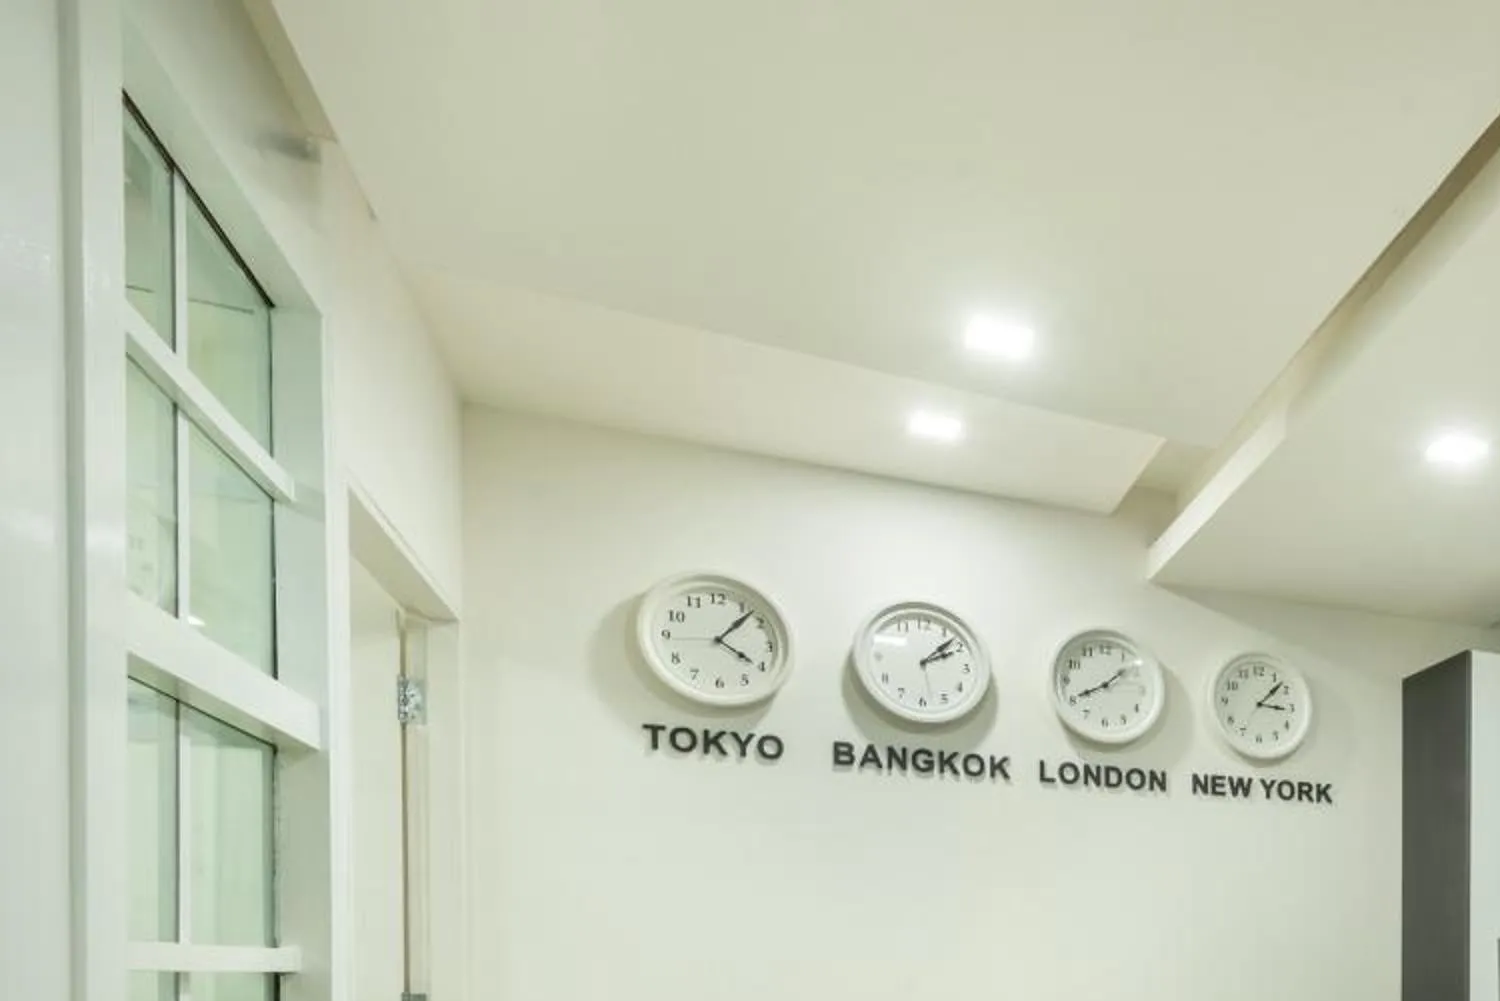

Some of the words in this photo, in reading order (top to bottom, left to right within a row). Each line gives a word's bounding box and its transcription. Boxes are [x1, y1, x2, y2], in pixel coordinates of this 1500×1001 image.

[687, 595, 701, 608] 11
[710, 592, 726, 605] 12
[739, 602, 744, 613] 1
[668, 609, 685, 623] 10
[756, 617, 764, 629] 2
[661, 629, 671, 640] 9
[767, 641, 773, 652] 3
[671, 652, 681, 664] 8
[758, 661, 765, 672] 4
[690, 668, 699, 680] 7
[740, 673, 749, 686] 5
[715, 677, 725, 688] 6
[642, 724, 784, 760] TOKYO
[832, 741, 1010, 779] BANGKOK
[1039, 760, 1167, 792] LONDON
[1191, 773, 1252, 798] NEW
[1260, 778, 1333, 804] YORK
